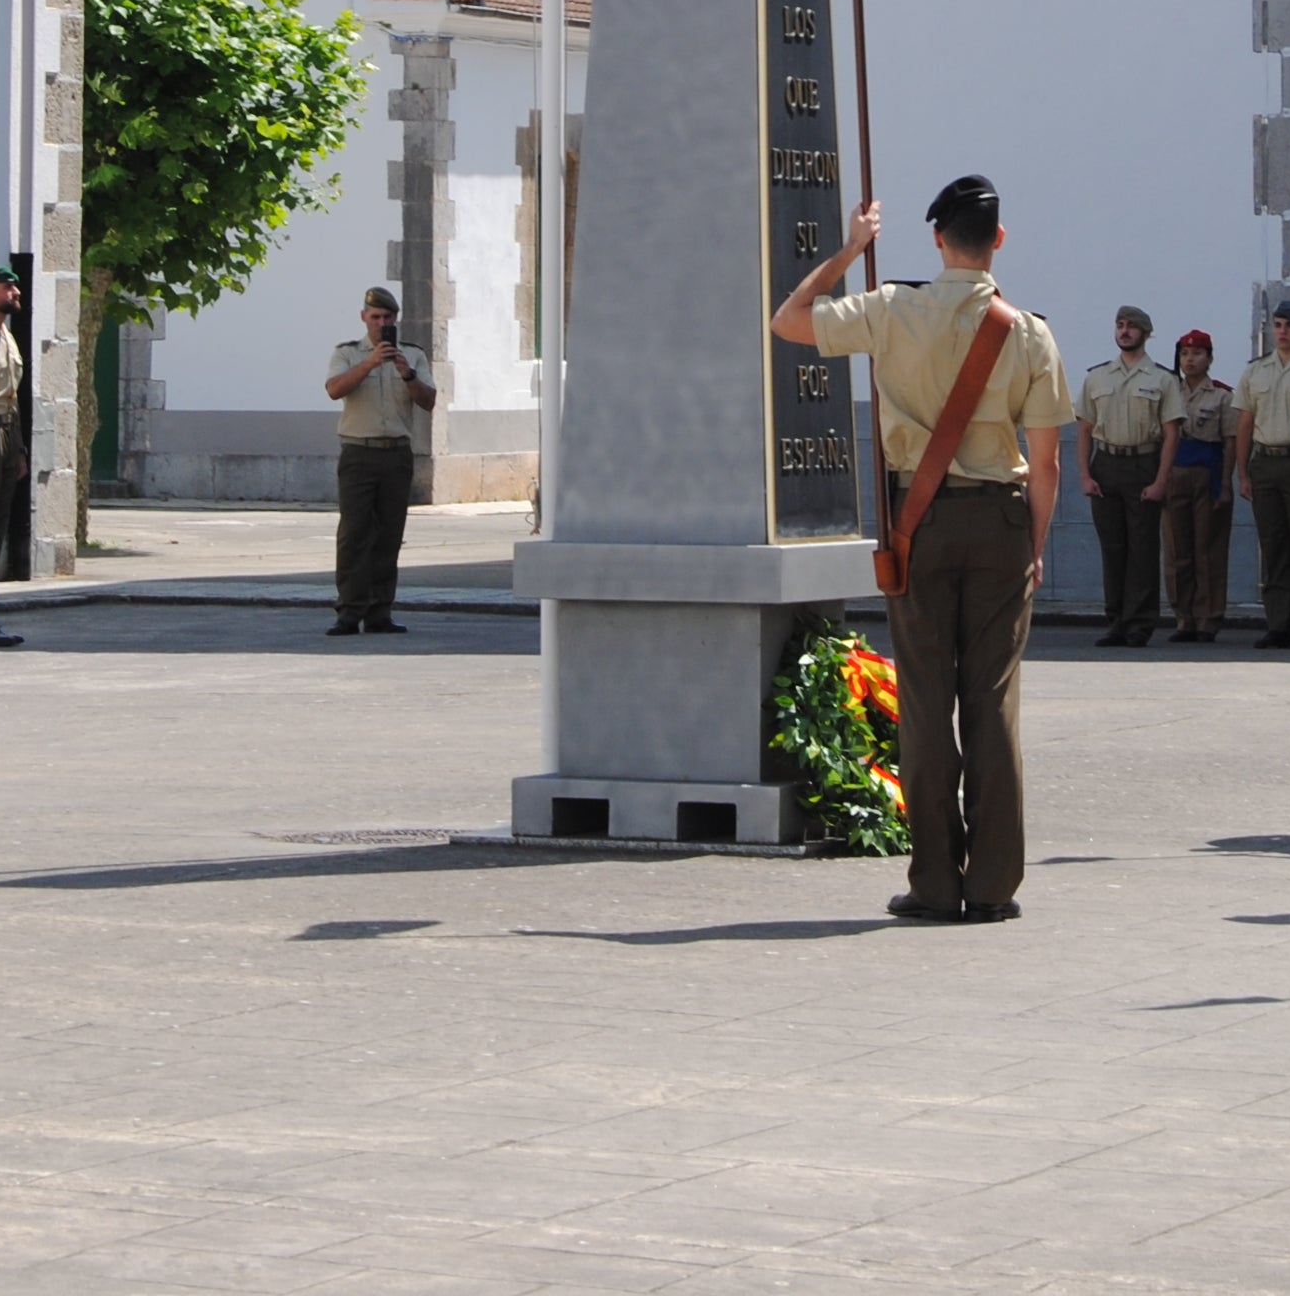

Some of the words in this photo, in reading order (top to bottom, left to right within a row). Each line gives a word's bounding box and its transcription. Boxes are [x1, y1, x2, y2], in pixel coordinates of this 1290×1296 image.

[783, 6, 816, 40] LOS
[785, 76, 820, 113] QUE
[772, 147, 837, 183] DIERON
[796, 221, 818, 252] SU
[798, 365, 829, 397] POR
[781, 428, 850, 470] ESPAÑA
